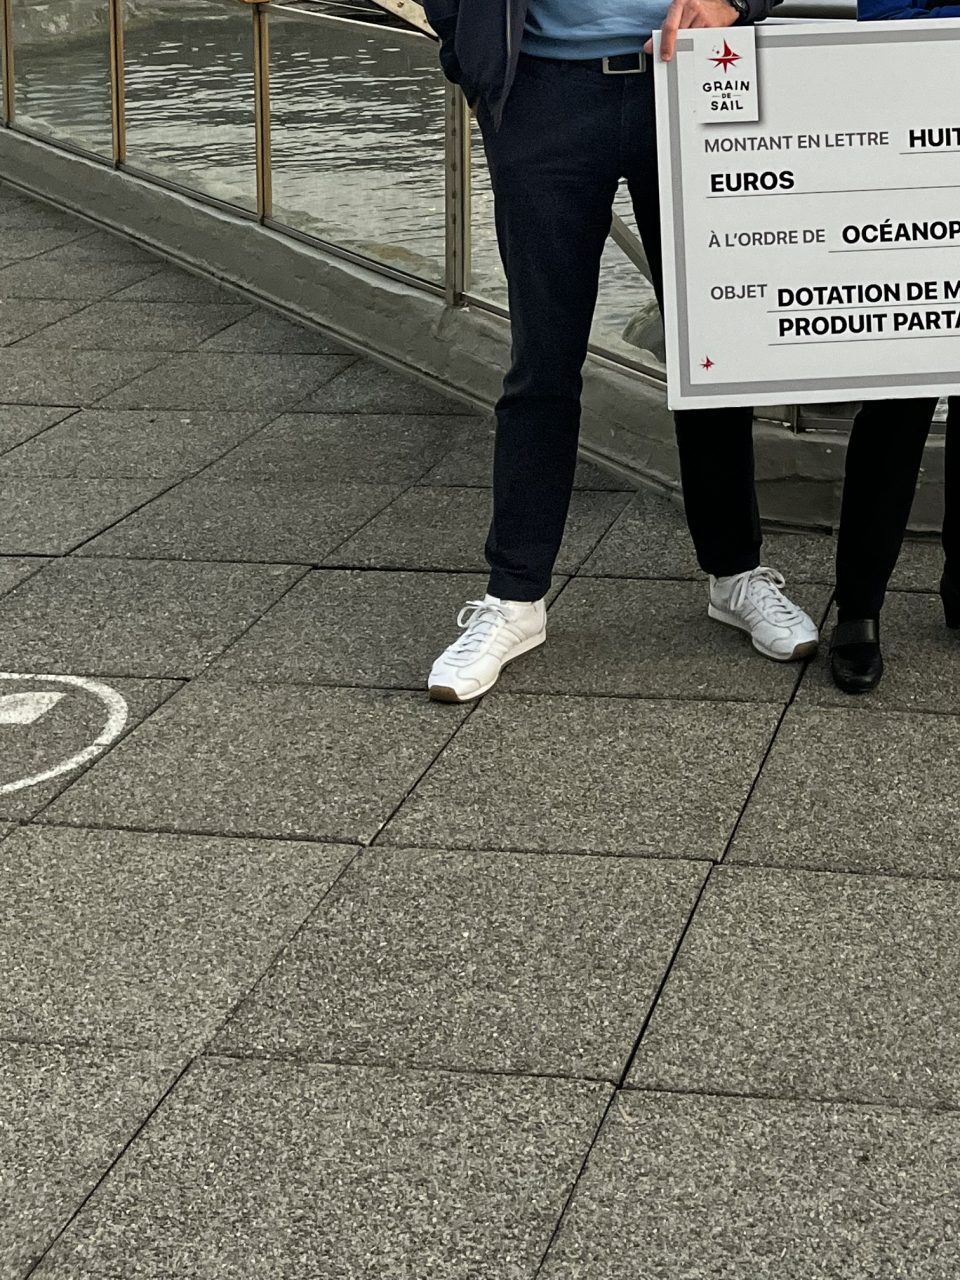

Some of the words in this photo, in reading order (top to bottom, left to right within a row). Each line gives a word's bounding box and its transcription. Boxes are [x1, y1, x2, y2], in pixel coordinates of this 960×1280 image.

[703, 80, 749, 92] GRAIN
[711, 100, 743, 111] SAIL
[705, 136, 793, 153] MONTANT
[798, 134, 820, 149] EN
[825, 132, 889, 147] LETTRE
[711, 171, 794, 192] EUROS
[709, 230, 720, 248] À
[725, 230, 798, 247] L'ORDRE
[803, 229, 825, 243] DE
[711, 284, 767, 300] OBJET
[778, 283, 901, 308] DOTATION
[907, 281, 938, 301] DE
[779, 313, 887, 337] PRODUIT
